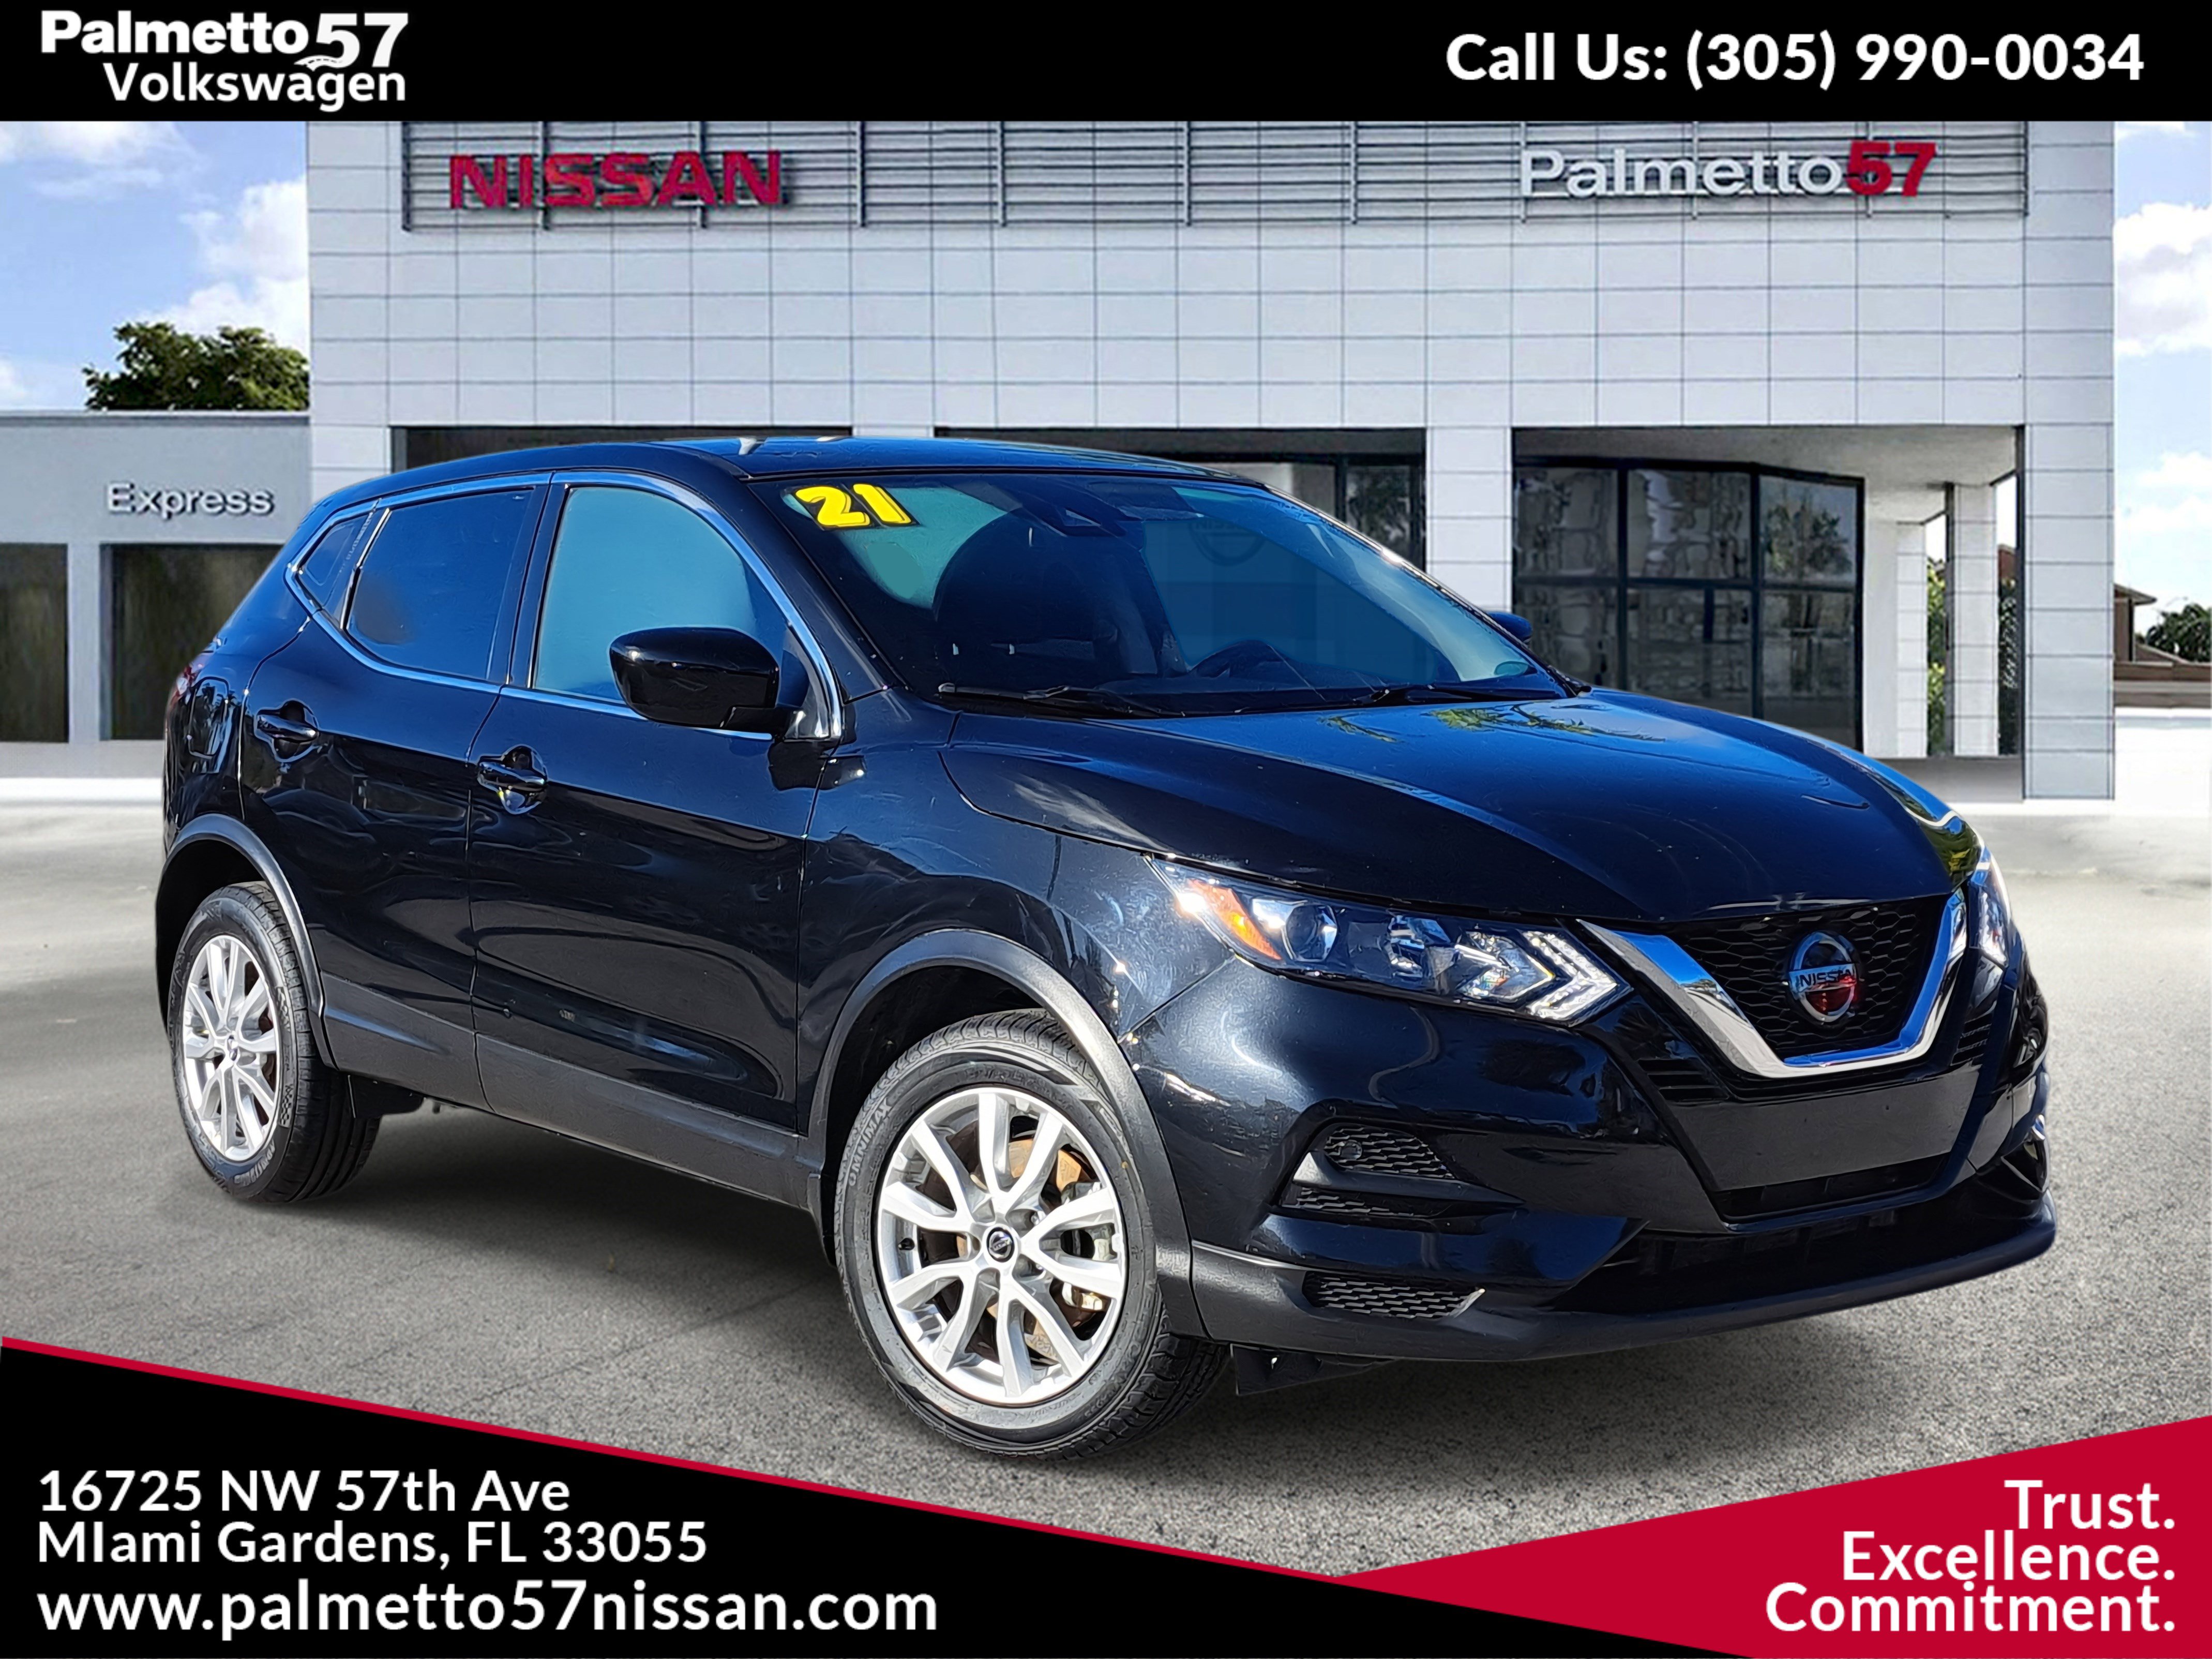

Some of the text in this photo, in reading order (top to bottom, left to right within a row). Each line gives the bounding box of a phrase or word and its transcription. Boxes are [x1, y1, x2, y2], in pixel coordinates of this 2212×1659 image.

[449, 150, 781, 209] NISSAN
[106, 482, 275, 520] Express
[795, 483, 915, 528] 21
